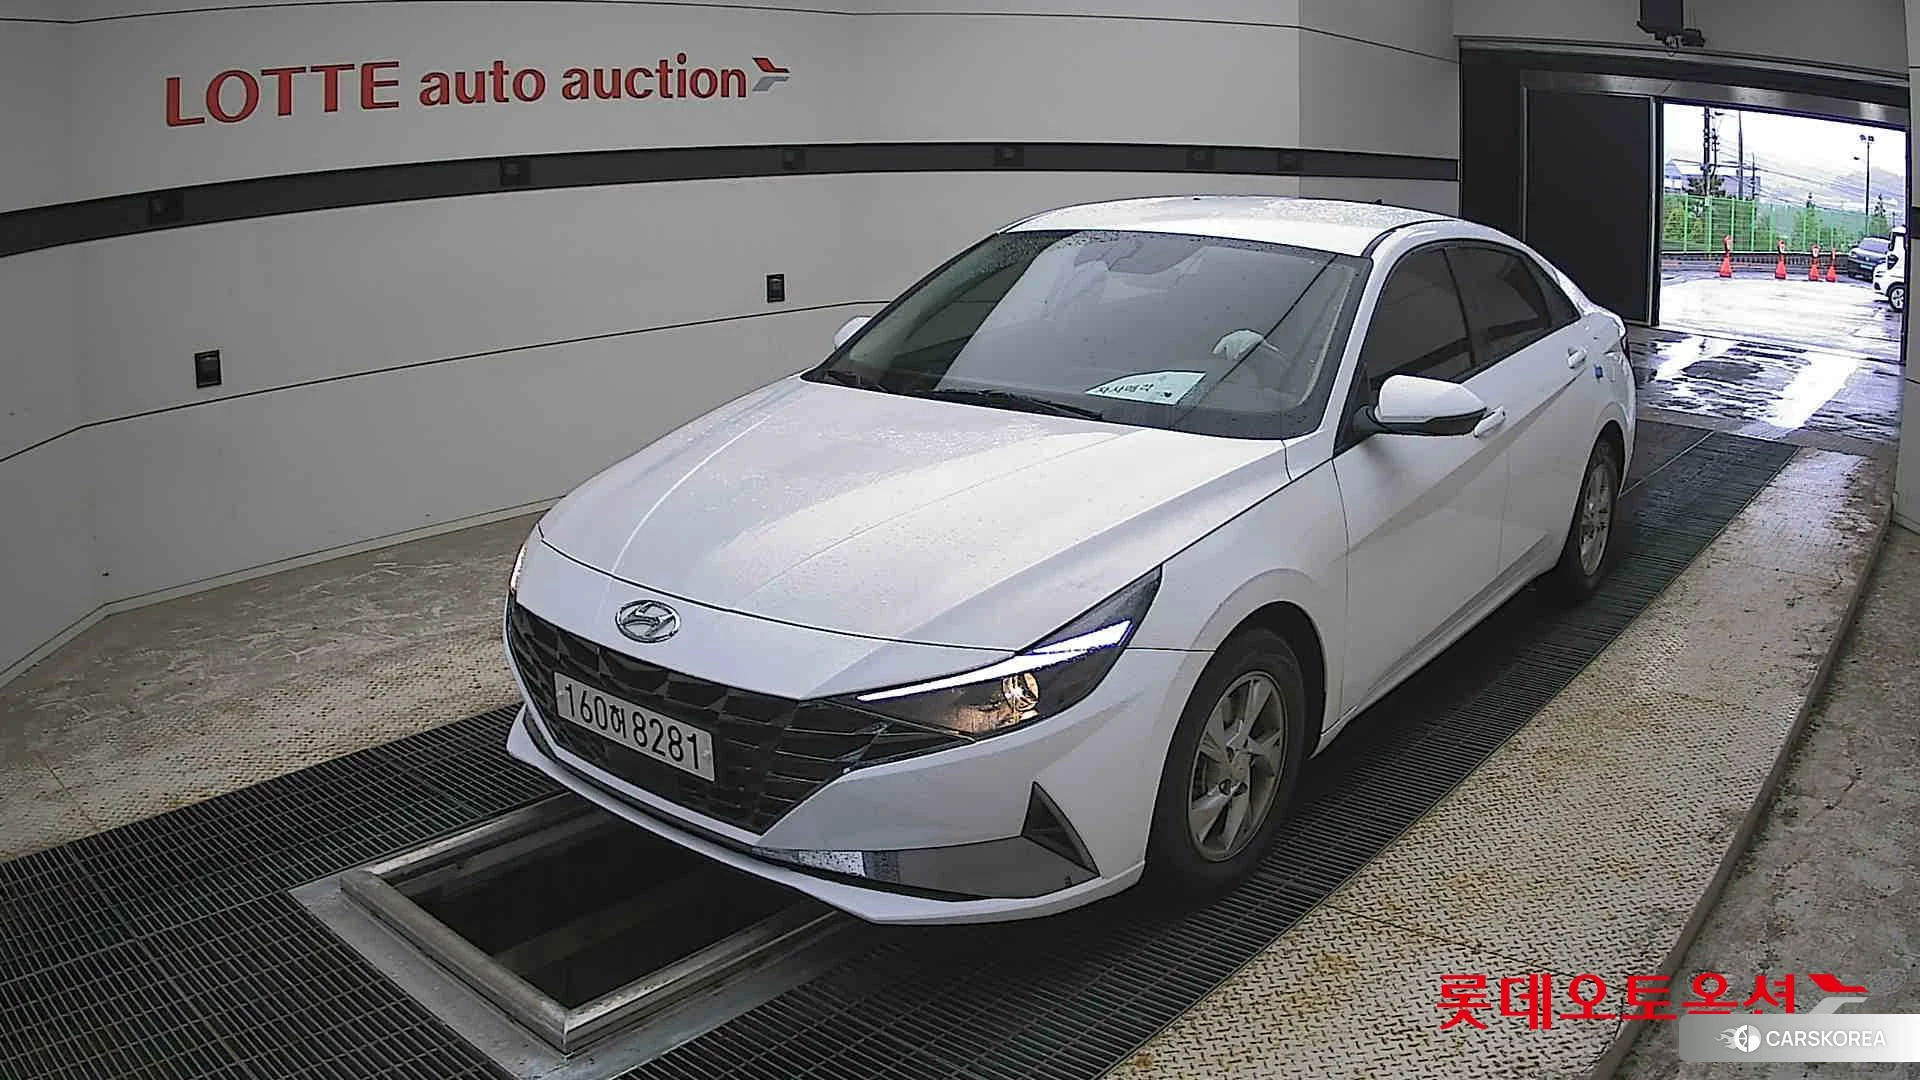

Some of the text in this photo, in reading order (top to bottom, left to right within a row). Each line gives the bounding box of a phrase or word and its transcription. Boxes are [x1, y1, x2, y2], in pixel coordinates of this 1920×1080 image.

[166, 52, 748, 127] LOTTE auto auction
